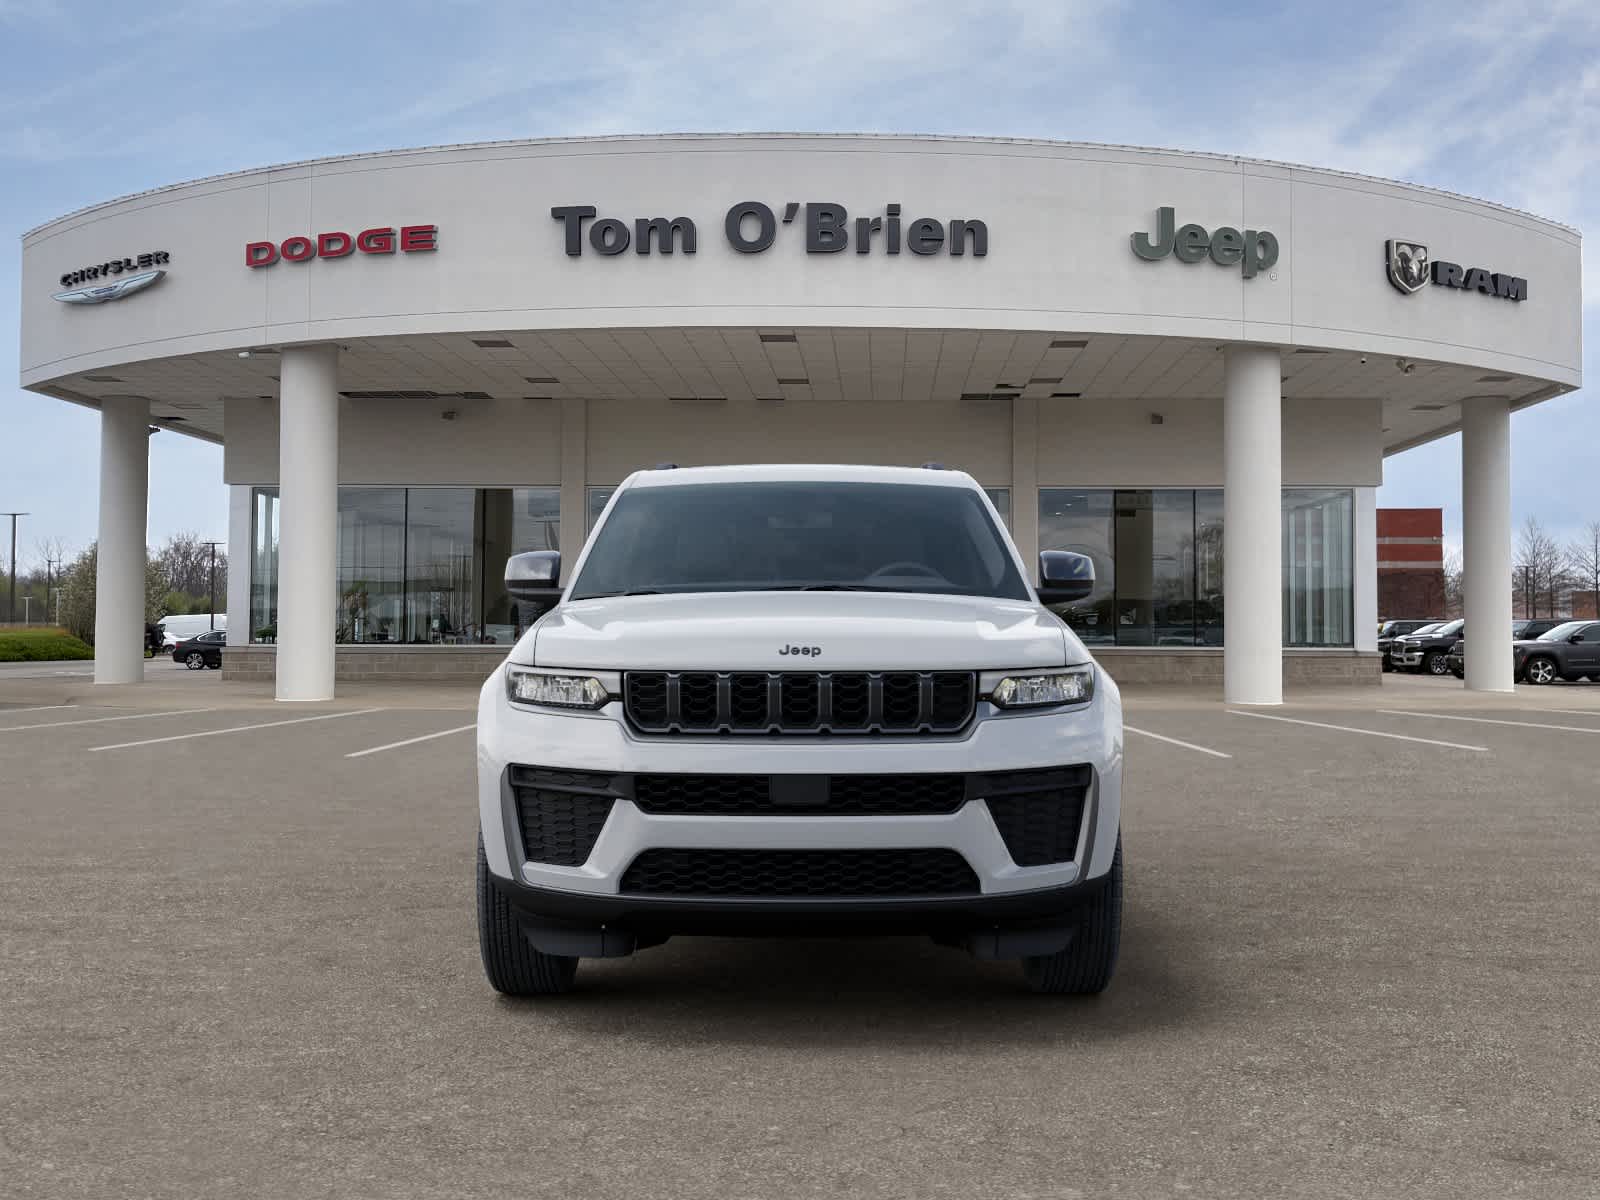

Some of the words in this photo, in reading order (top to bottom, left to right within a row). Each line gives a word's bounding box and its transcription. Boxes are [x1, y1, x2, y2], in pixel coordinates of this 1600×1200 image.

[245, 225, 439, 268] DODGE
[551, 205, 698, 256] Tom
[725, 200, 989, 257] O'Brien
[1130, 206, 1280, 279] Jeep
[60, 250, 170, 287] CHRYSLER
[1431, 260, 1528, 301] RAM
[779, 644, 822, 658] Jeep
